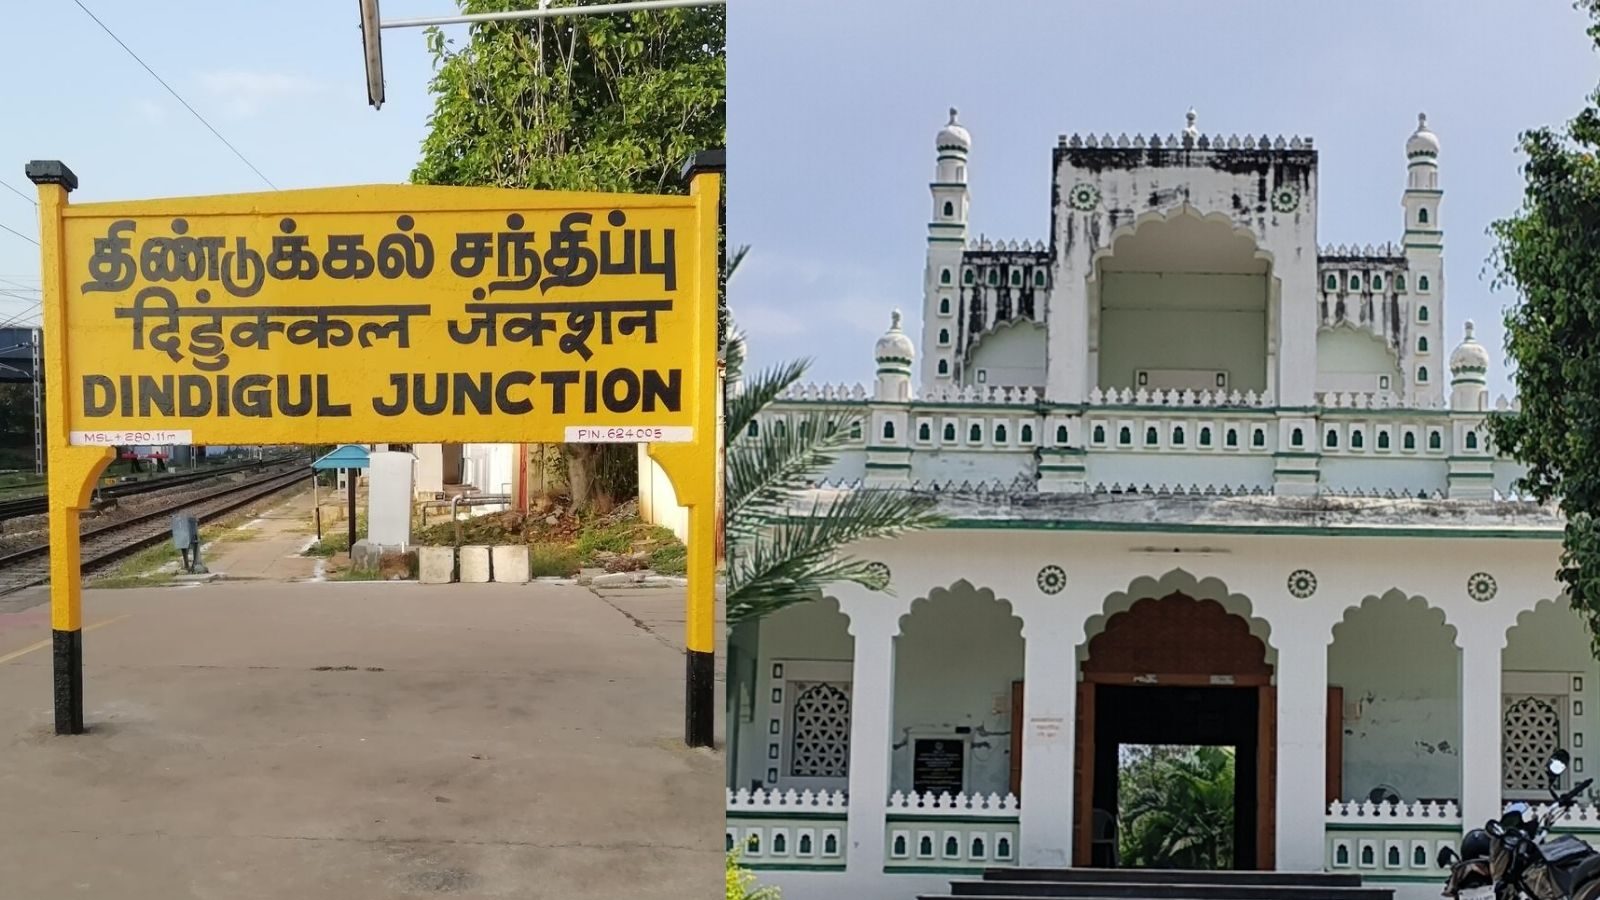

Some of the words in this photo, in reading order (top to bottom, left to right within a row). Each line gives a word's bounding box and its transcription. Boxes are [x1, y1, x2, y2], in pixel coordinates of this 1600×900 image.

[81, 214, 435, 298] திண்டுக்கல்
[450, 209, 677, 296] சந்திப்பு
[447, 286, 673, 362] जंक्शन
[82, 373, 352, 418] DINDIGUL
[373, 368, 682, 418] JUNCTION
